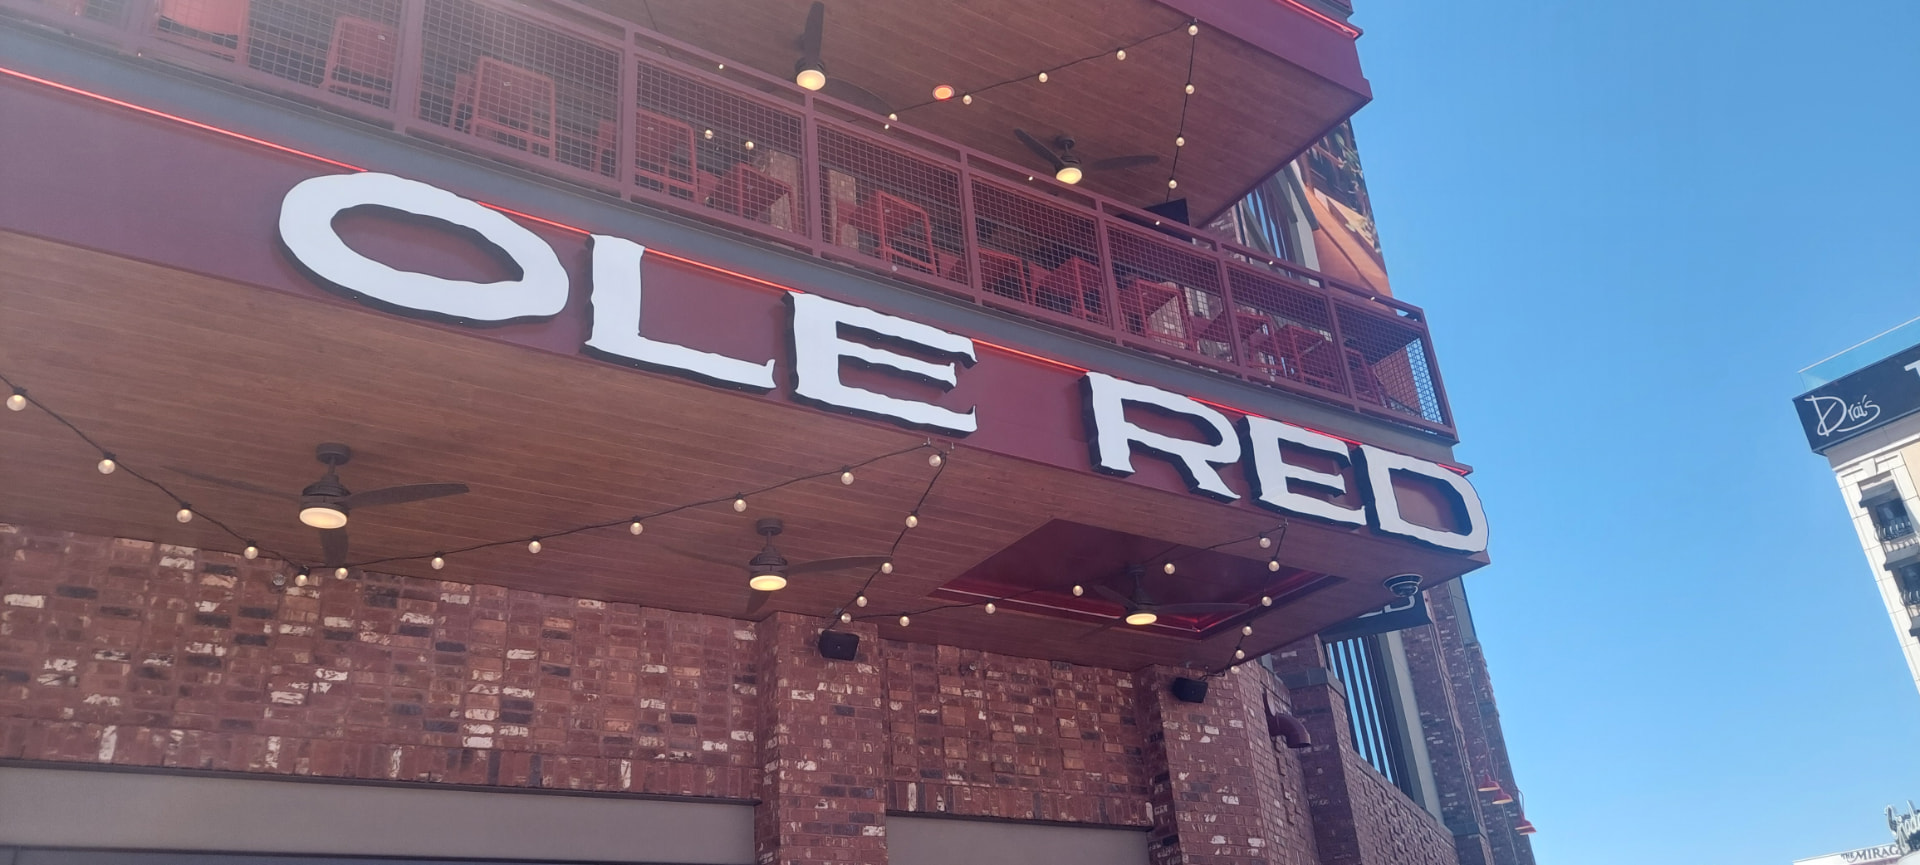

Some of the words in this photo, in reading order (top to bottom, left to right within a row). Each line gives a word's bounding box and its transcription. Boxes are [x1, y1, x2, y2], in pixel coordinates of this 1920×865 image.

[279, 171, 978, 437] OLE
[1083, 371, 1489, 553] RED
[1804, 395, 1881, 437] Drai's
[1851, 844, 1899, 862] MIRAG
